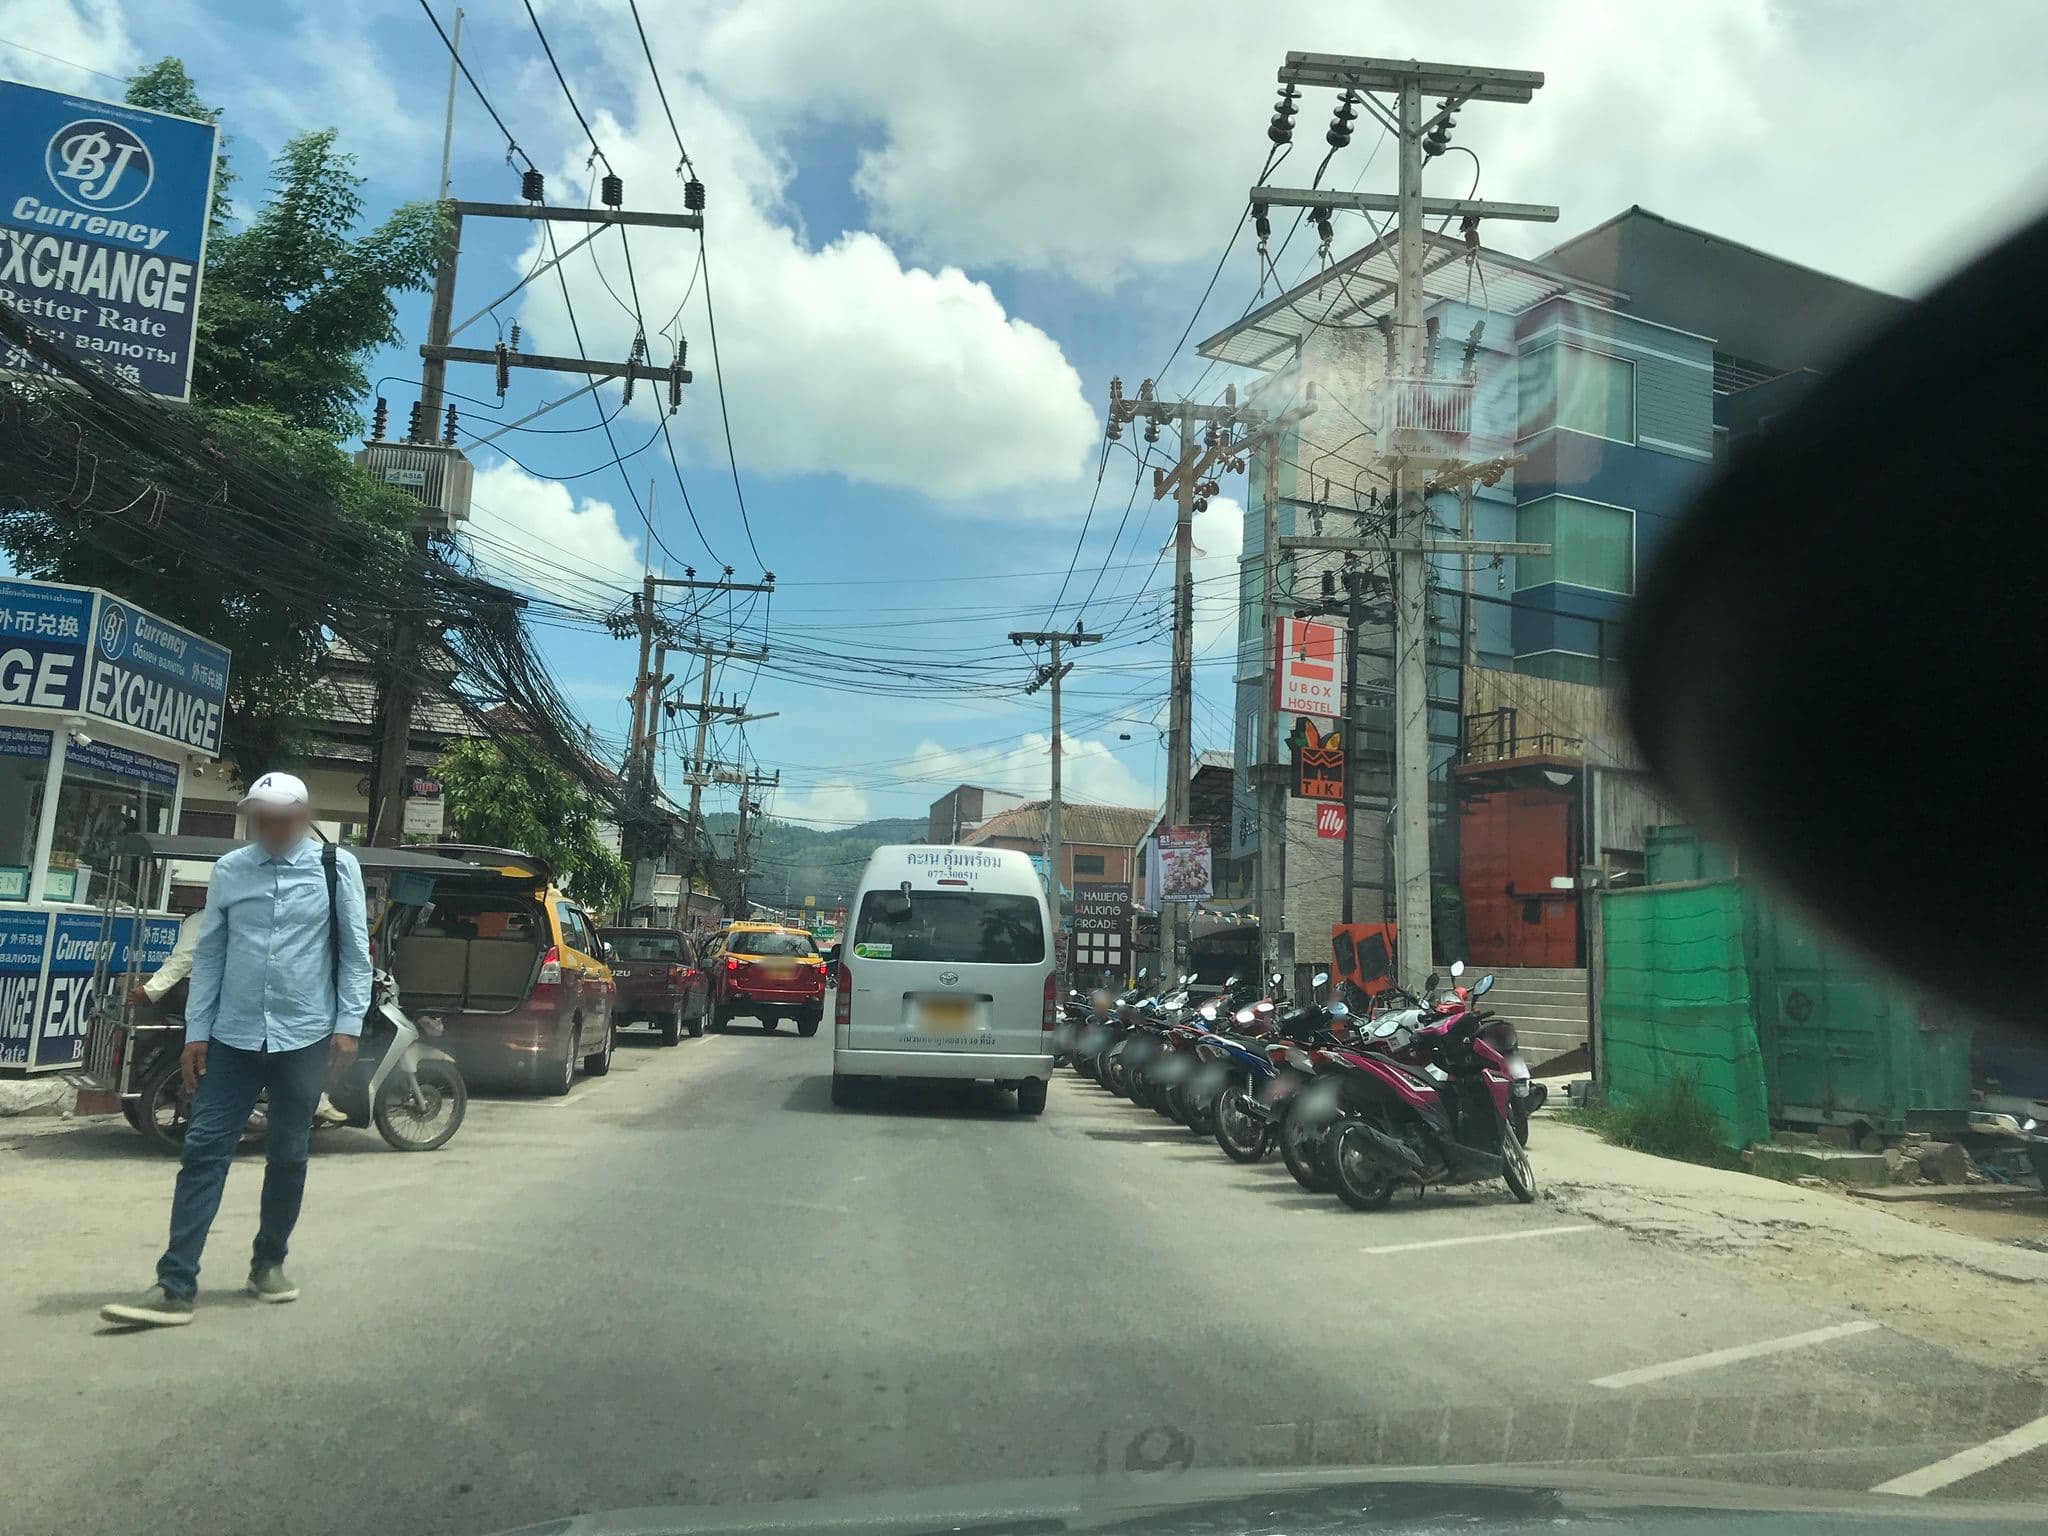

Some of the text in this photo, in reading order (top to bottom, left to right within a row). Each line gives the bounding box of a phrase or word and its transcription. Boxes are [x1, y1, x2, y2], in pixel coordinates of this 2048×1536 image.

[12, 196, 170, 250] Currency
[96, 305, 167, 338] Rate
[135, 615, 188, 659] Currency
[1289, 681, 1331, 698] UBOX
[90, 660, 220, 750] EXCHANGE
[1288, 697, 1333, 713] HOSTEL
[1320, 809, 1344, 836] illy
[928, 870, 979, 879] 077-300511
[1075, 891, 1128, 902] CHAWENG
[1075, 904, 1121, 915] WALKING
[1074, 918, 1117, 929] ARCADE
